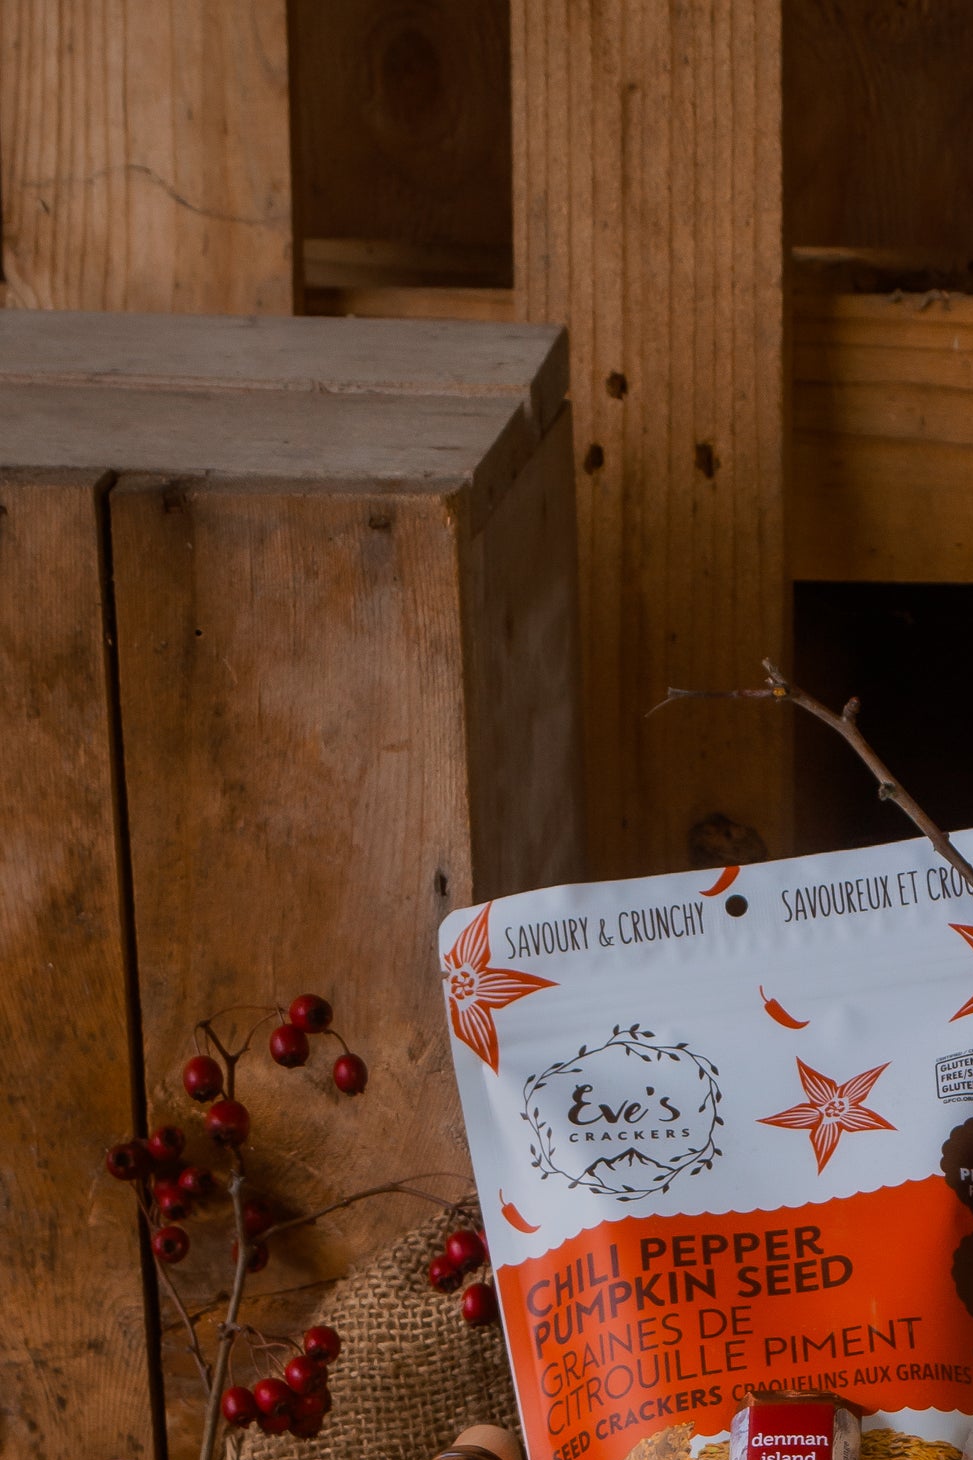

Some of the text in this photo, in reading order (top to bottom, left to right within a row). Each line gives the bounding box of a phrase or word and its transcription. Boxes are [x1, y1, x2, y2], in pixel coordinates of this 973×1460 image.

[780, 875, 892, 923] SAVOUREUX
[897, 871, 917, 906] ET
[505, 902, 704, 960] SAVOURY & CRUNCHY
[568, 1084, 681, 1126] Eve's
[569, 1128, 690, 1142] CRACKERS
[526, 1225, 824, 1318] CHILI PEPPER
[533, 1254, 854, 1360] PUMPKIN SEED
[540, 1305, 753, 1398] GRAINES DE
[546, 1339, 748, 1437] CITROUILLE
[764, 1317, 922, 1367] PIMENT
[853, 1364, 892, 1387] AUX
[896, 1362, 973, 1386] GRAINES
[595, 1385, 722, 1441] CRACKERS
[751, 1432, 829, 1447] denman
